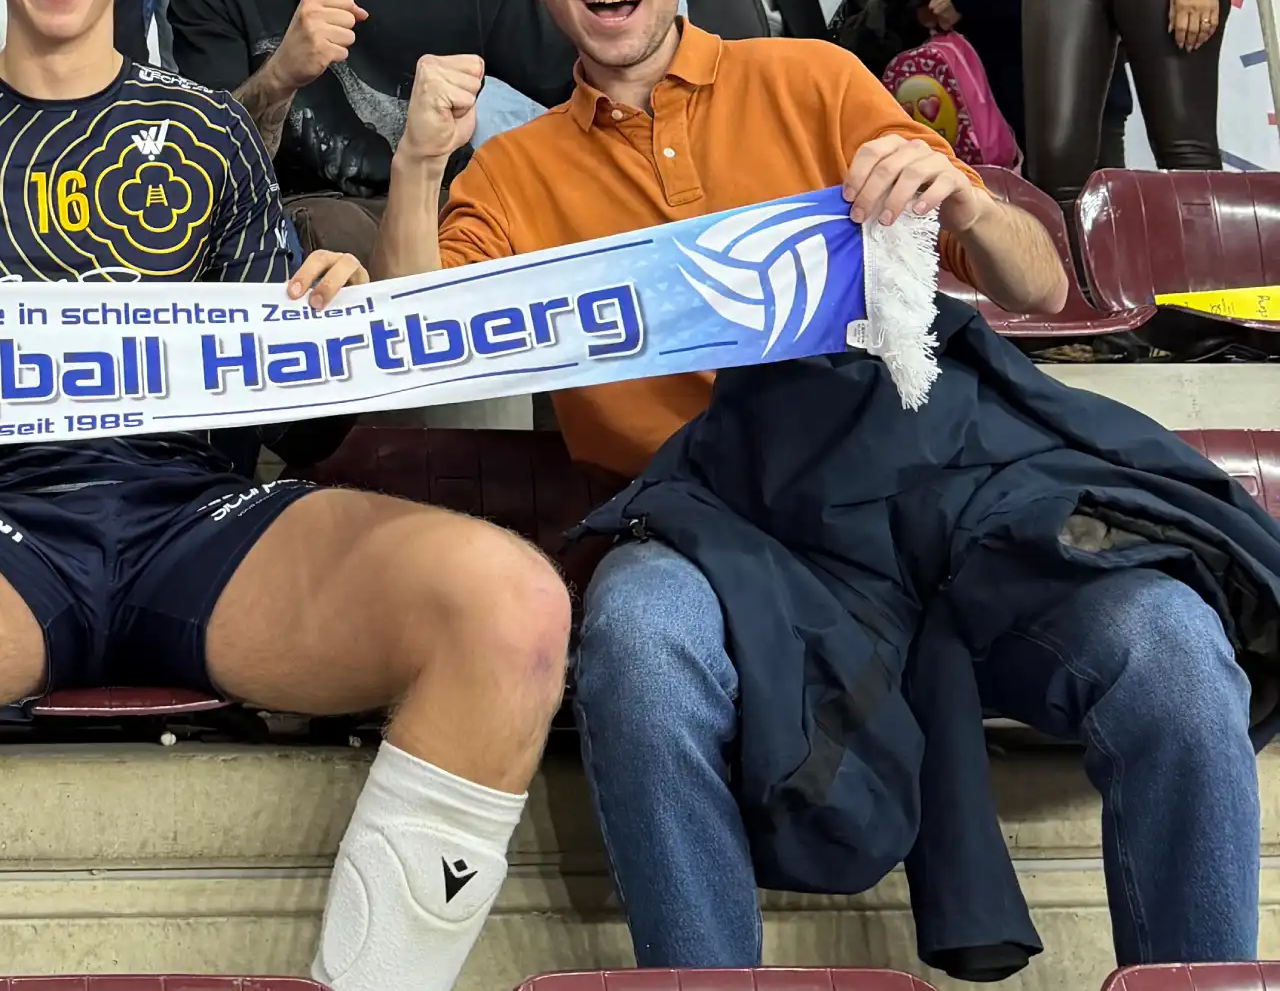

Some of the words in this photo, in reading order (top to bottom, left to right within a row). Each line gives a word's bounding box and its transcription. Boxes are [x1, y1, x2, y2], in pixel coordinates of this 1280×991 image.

[30, 170, 90, 233] 16
[19, 303, 48, 326] in
[61, 302, 249, 326] schlechten
[201, 284, 643, 390] Hartberg
[64, 412, 144, 434] 1985
